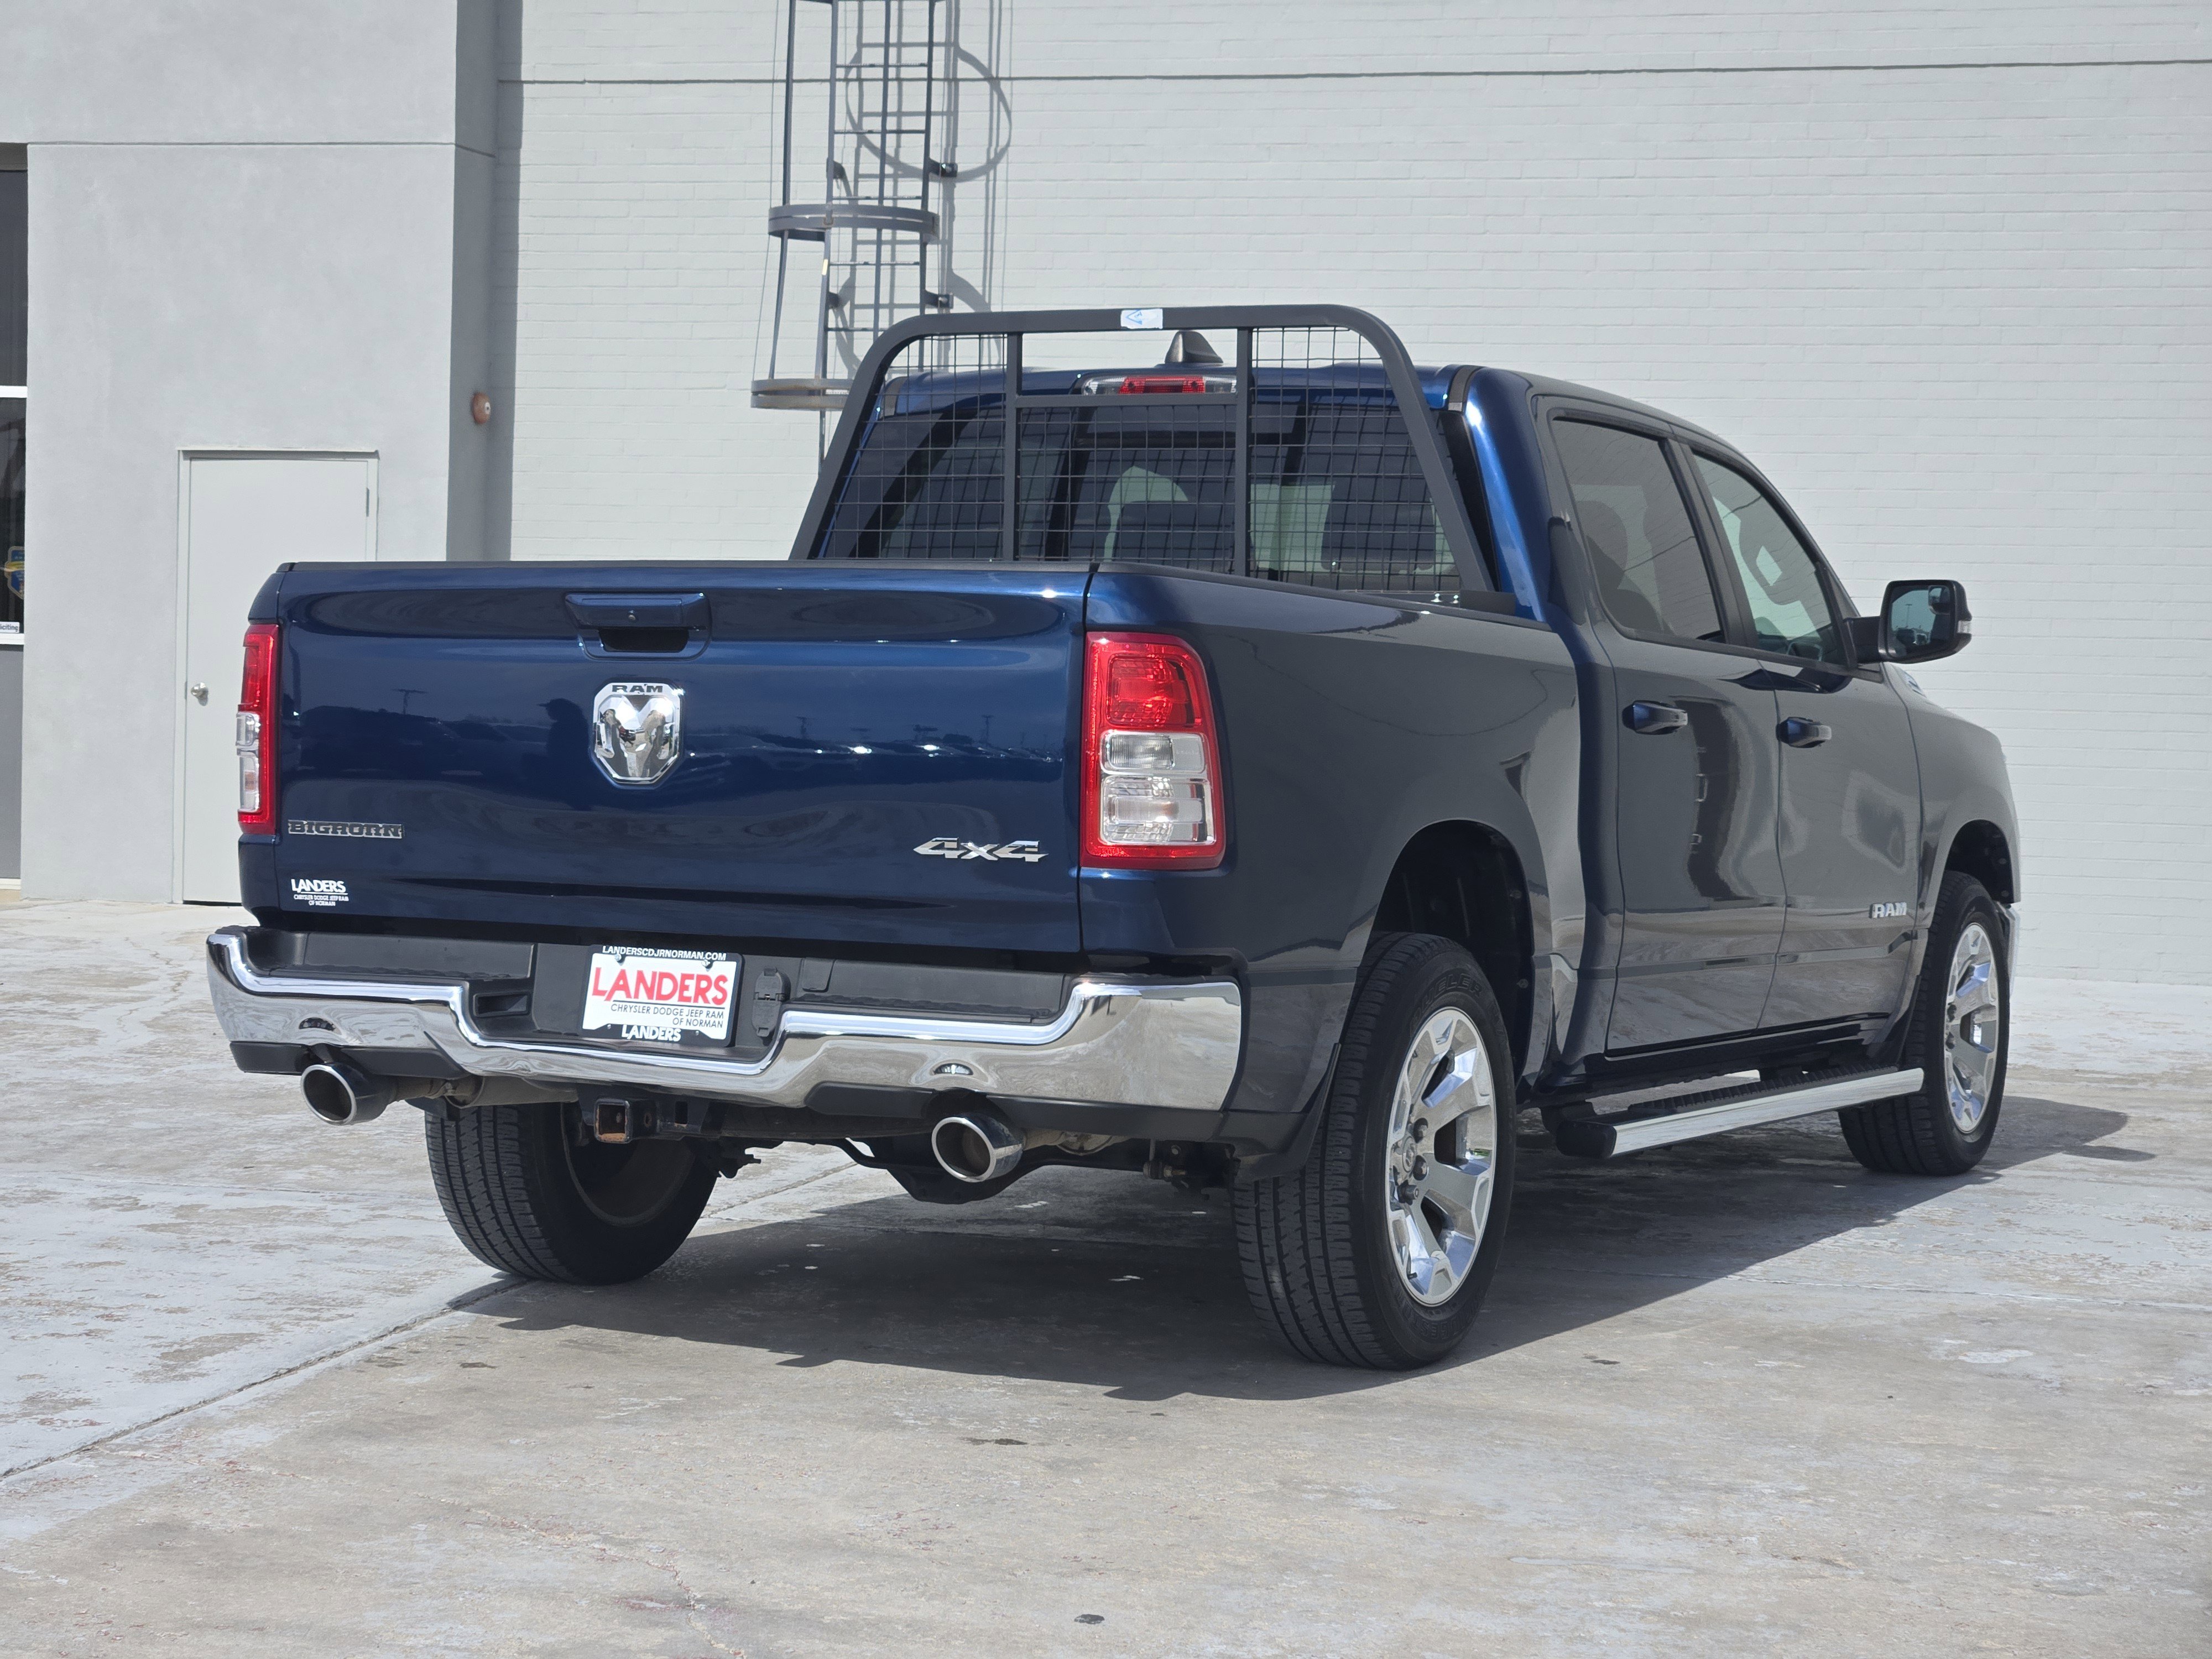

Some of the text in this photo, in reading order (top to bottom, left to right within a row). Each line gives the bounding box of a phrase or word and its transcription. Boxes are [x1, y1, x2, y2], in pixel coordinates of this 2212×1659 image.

[612, 685, 663, 693] RAM
[288, 820, 403, 839] BIGHORN
[291, 879, 346, 893] LANDERS
[1871, 901, 1907, 919] RAM
[602, 946, 727, 961] LANDERSCDJRNORMAN.COM
[592, 967, 729, 1005] LANDERS
[611, 1004, 724, 1019] CHRYSLER DODGE JEEP RAM
[672, 1017, 723, 1029] OF NORMAN
[621, 1024, 682, 1042] LANDERS
